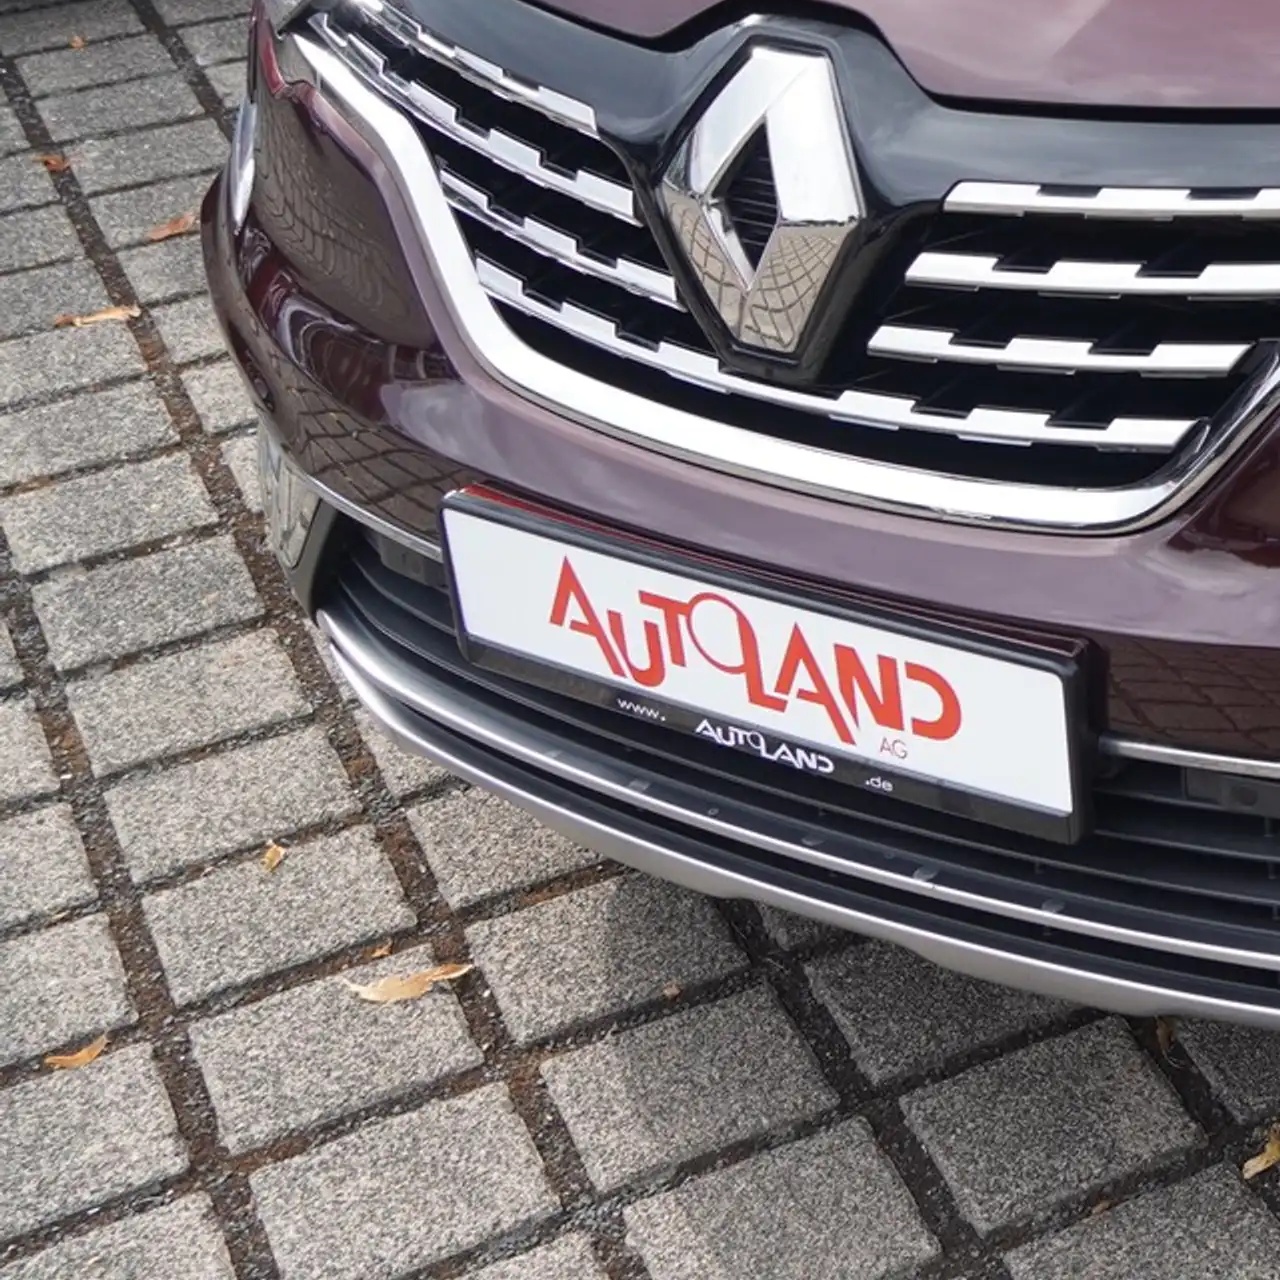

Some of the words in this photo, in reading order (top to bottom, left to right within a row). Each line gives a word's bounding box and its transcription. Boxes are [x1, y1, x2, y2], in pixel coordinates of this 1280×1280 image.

[549, 555, 962, 746] AUTOLAND
[879, 735, 908, 760] AG
[617, 697, 667, 722] www.
[695, 719, 835, 774] AUTOLAND
[864, 775, 893, 793] .de
